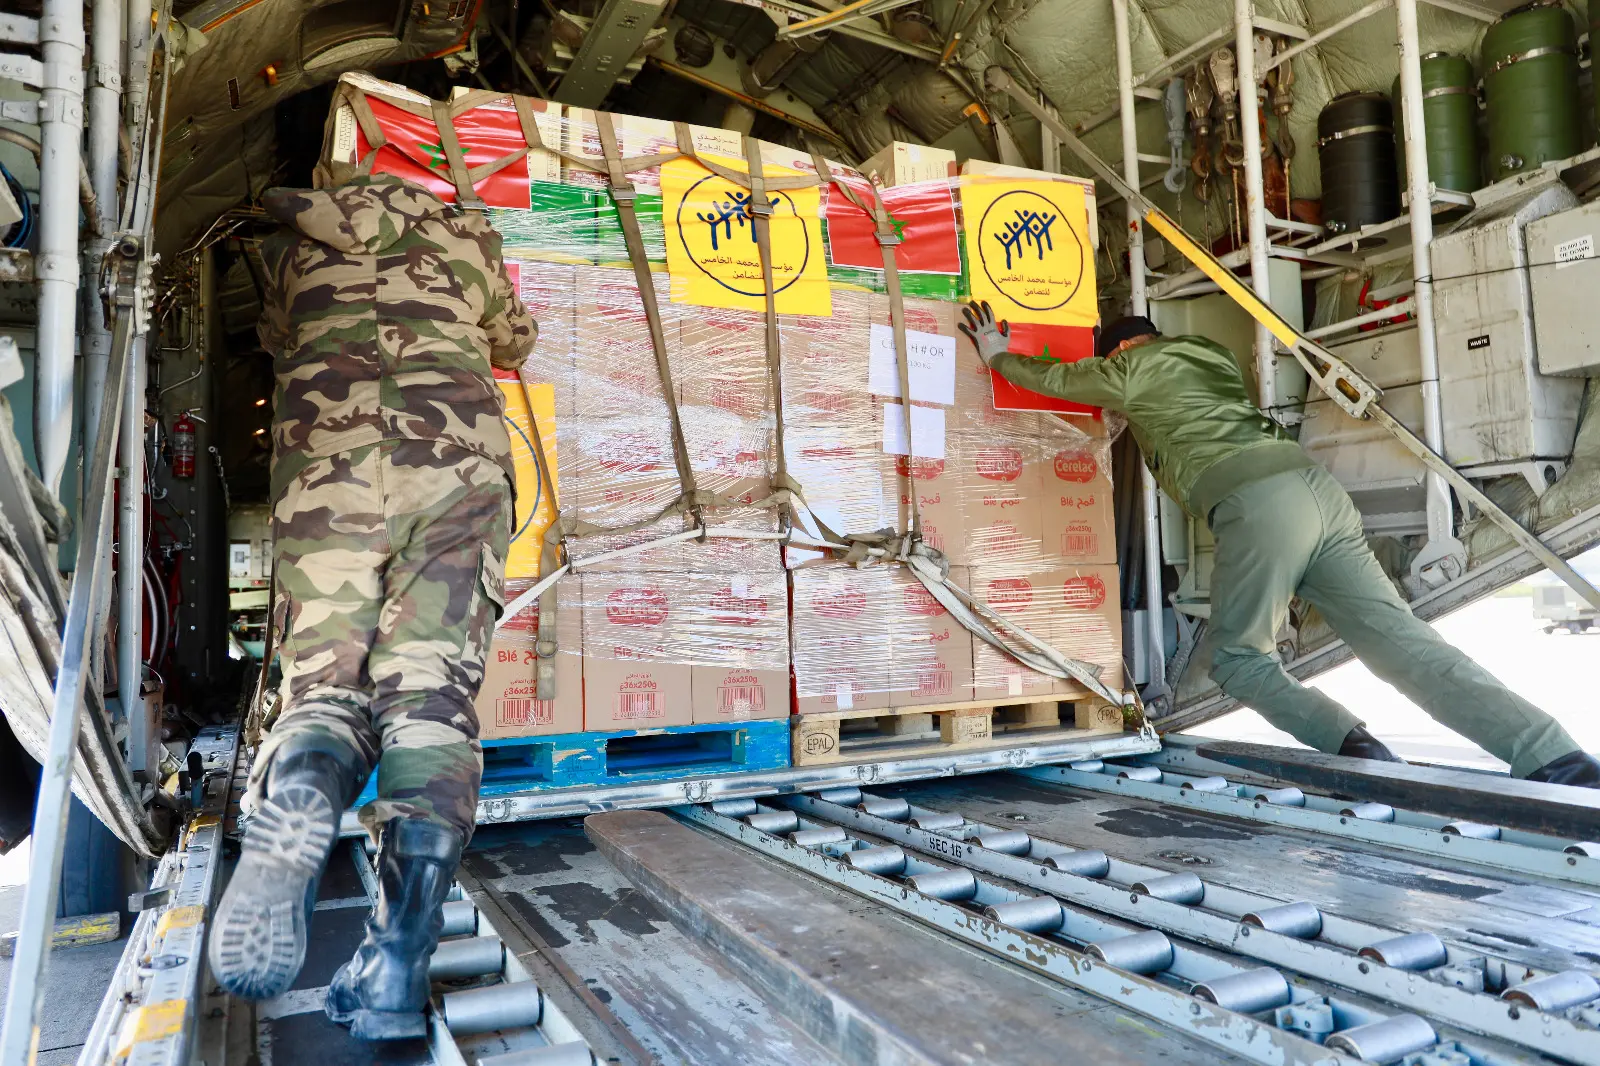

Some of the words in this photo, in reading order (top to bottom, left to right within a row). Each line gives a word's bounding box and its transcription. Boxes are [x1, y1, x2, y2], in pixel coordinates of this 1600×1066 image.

[700, 255, 732, 265] الخامس
[736, 260, 760, 268] محمد
[997, 273, 1024, 284] الخامس
[1048, 275, 1072, 288] مؤسسة
[1023, 287, 1051, 297] للتضامن
[1055, 459, 1095, 473] Cerelac
[920, 492, 941, 508] قمح
[1061, 496, 1074, 507] Blé
[1077, 494, 1095, 510] قمح
[929, 628, 950, 644] قمح
[497, 649, 518, 663] Blé
[807, 738, 831, 751] EPAL
[929, 836, 949, 854] SEC
